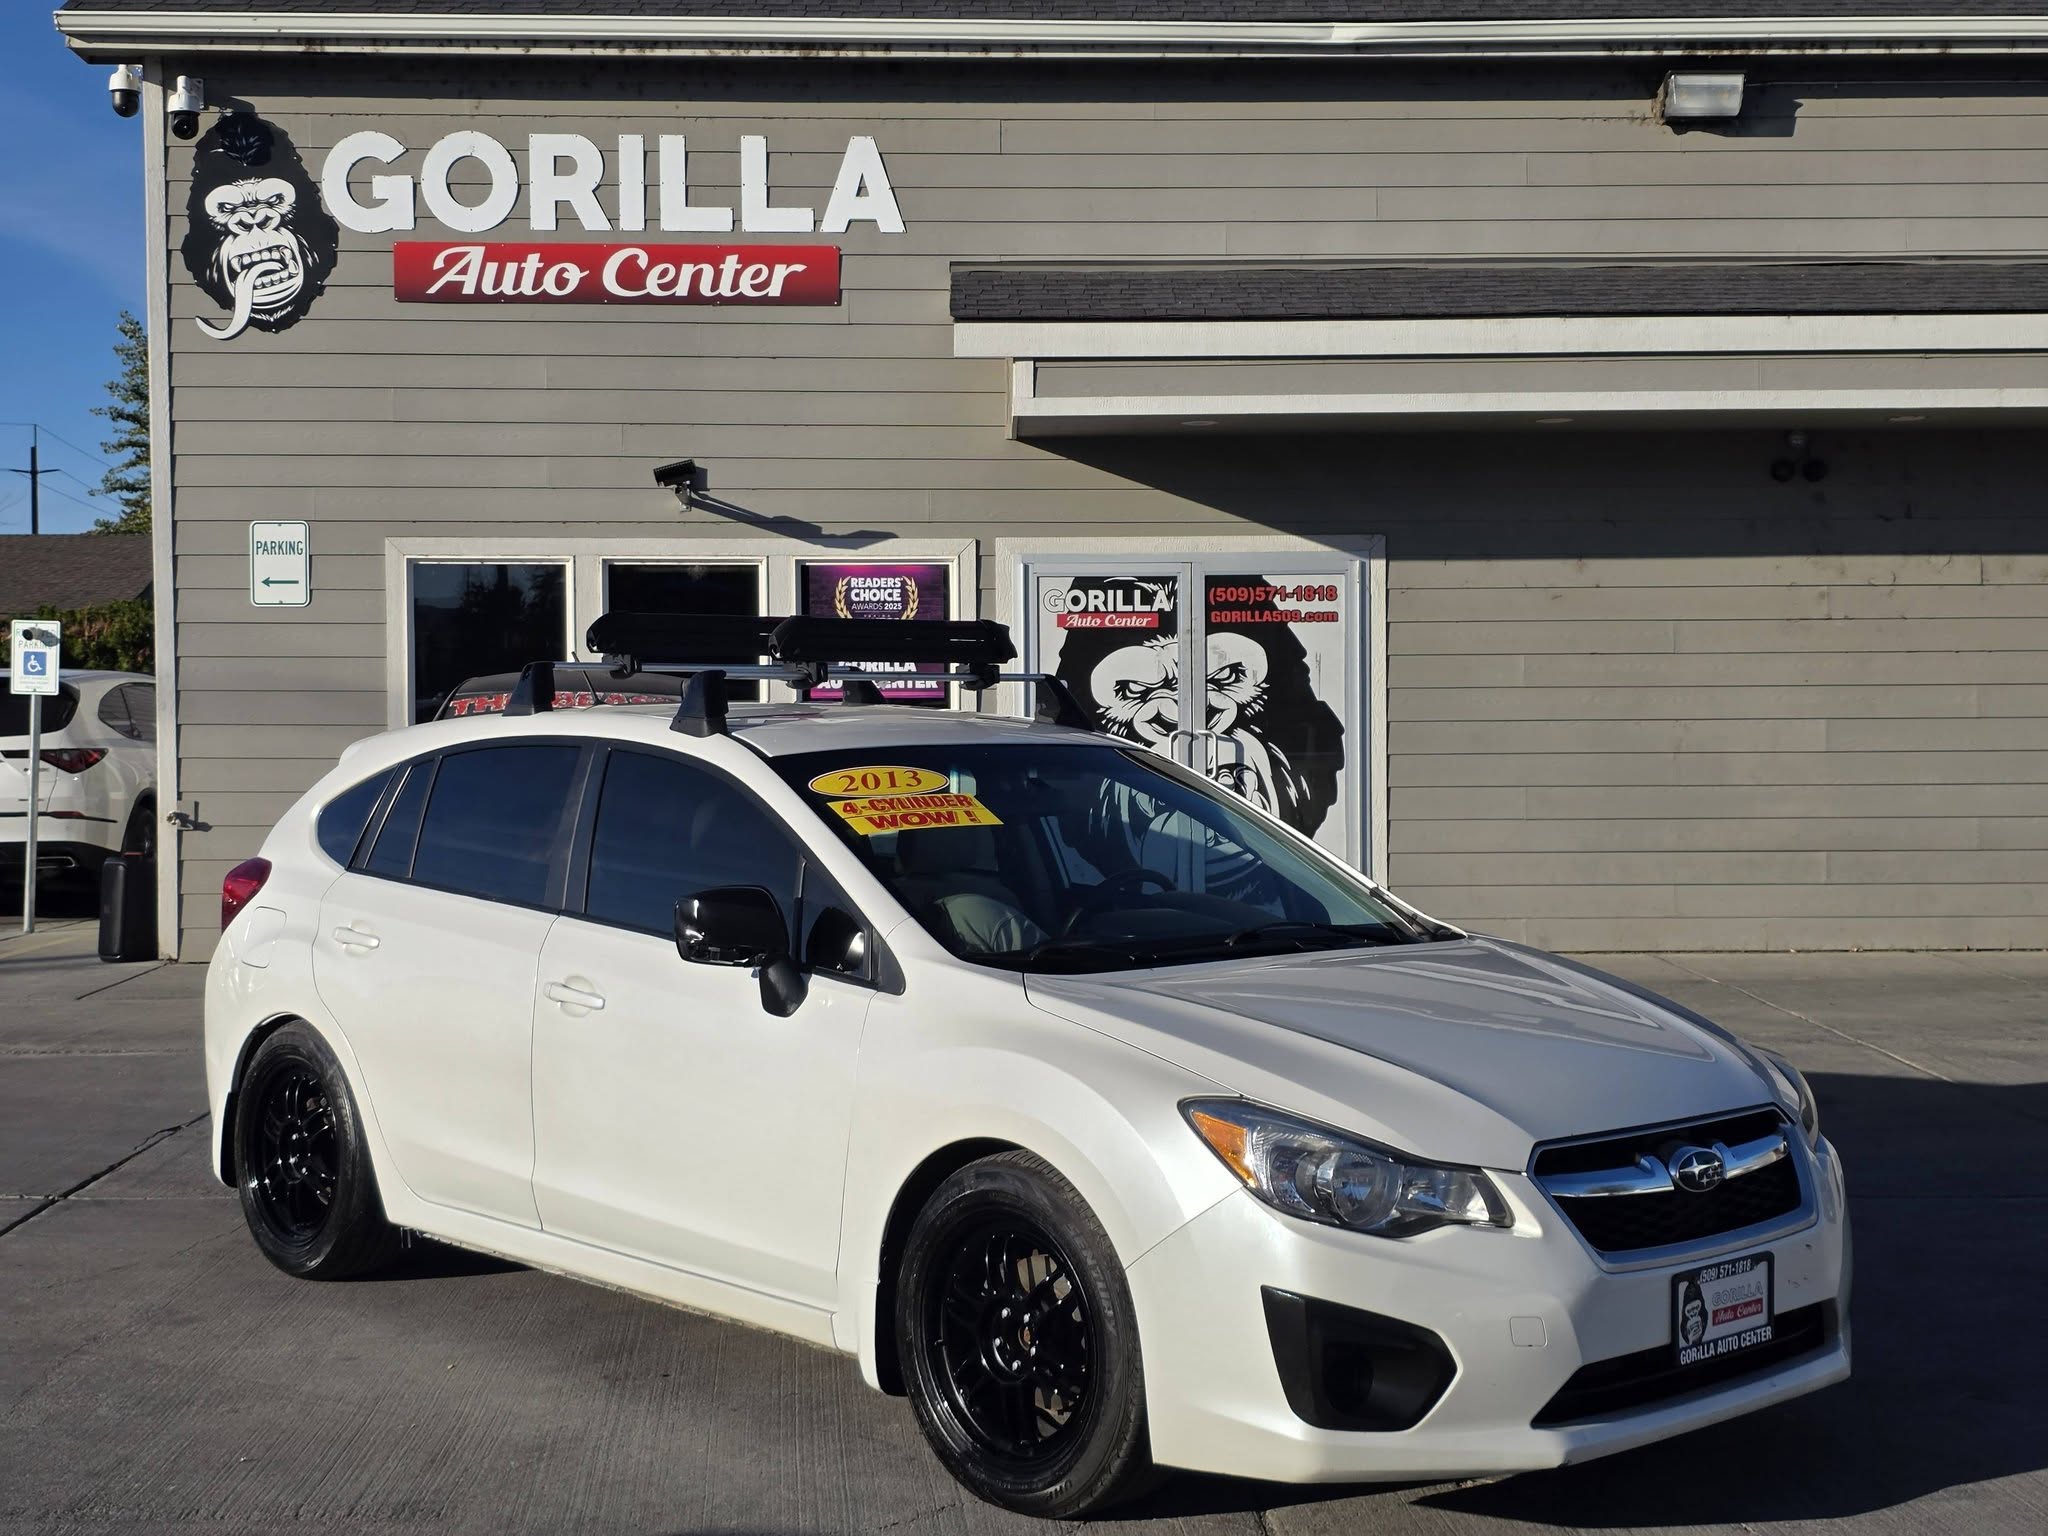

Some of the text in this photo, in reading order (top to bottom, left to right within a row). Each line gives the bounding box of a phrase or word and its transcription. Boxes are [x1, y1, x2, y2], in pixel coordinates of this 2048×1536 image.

[322, 130, 906, 234] GORILLA
[425, 245, 807, 297] Auto Center
[255, 540, 304, 556] PARKING
[850, 588, 902, 601] CHOICE
[1043, 588, 1171, 613] GORILLA
[1209, 585, 1338, 605] (509)571-1818
[851, 602, 902, 610] AWARDS 2025
[1210, 609, 1339, 623] GORILLA509.com
[1065, 614, 1152, 627] Auto Center
[838, 770, 923, 793] 2013
[842, 794, 976, 815] 4-CYLINDER
[1717, 1335, 1738, 1356] AUTO
[1740, 1326, 1772, 1347] CENTER
